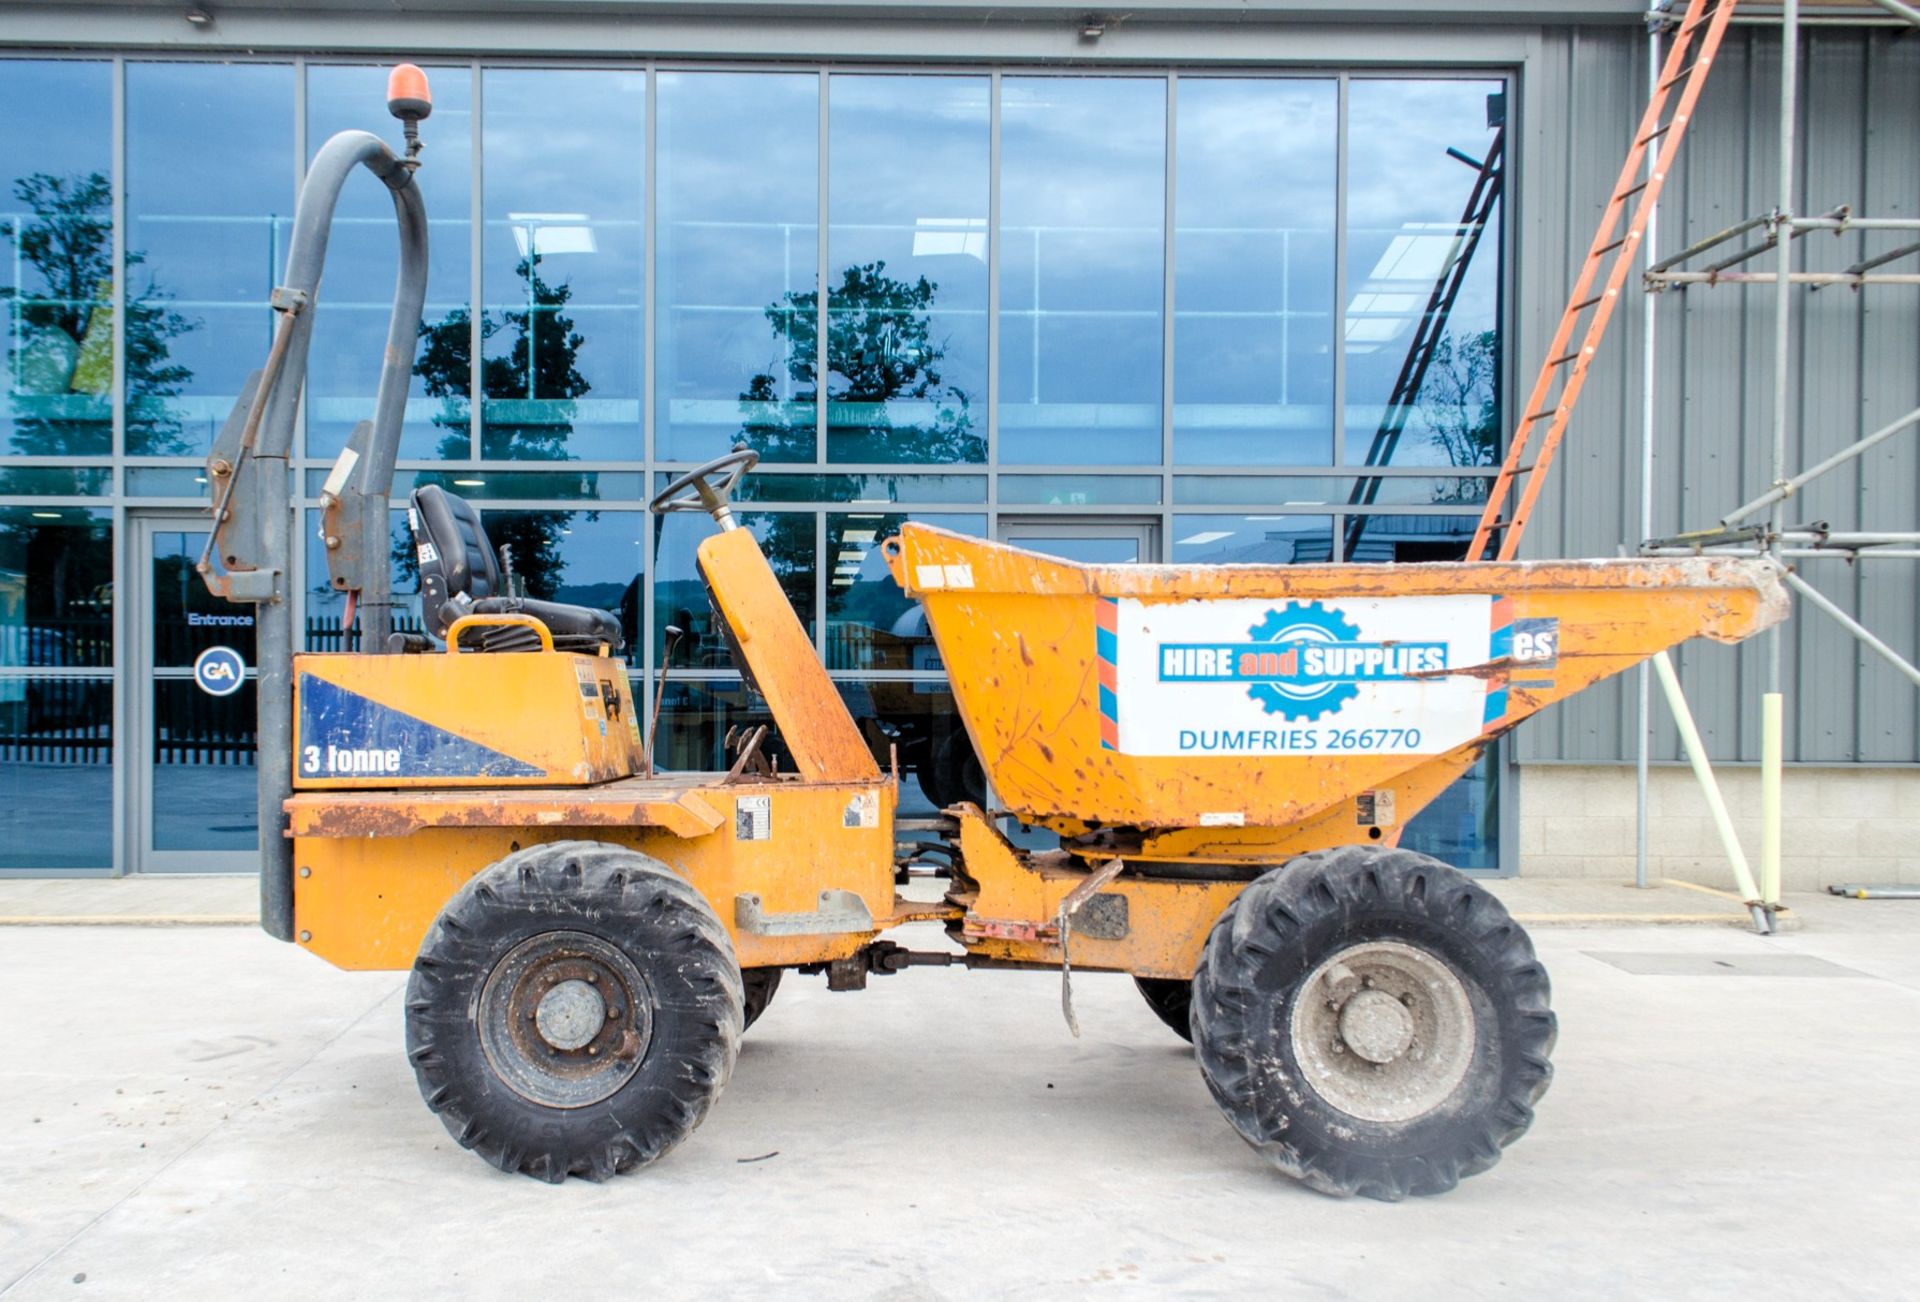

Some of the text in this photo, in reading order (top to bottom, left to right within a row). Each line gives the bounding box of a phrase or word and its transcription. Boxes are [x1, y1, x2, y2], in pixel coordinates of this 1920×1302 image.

[188, 612, 254, 626] Entrance
[1513, 632, 1553, 661] es
[202, 661, 236, 681] GA
[1163, 647, 1446, 677] HIRE and SUPPLIES
[1179, 728, 1421, 750] DUMFRIES 266770
[304, 745, 401, 773] 3 tonne
